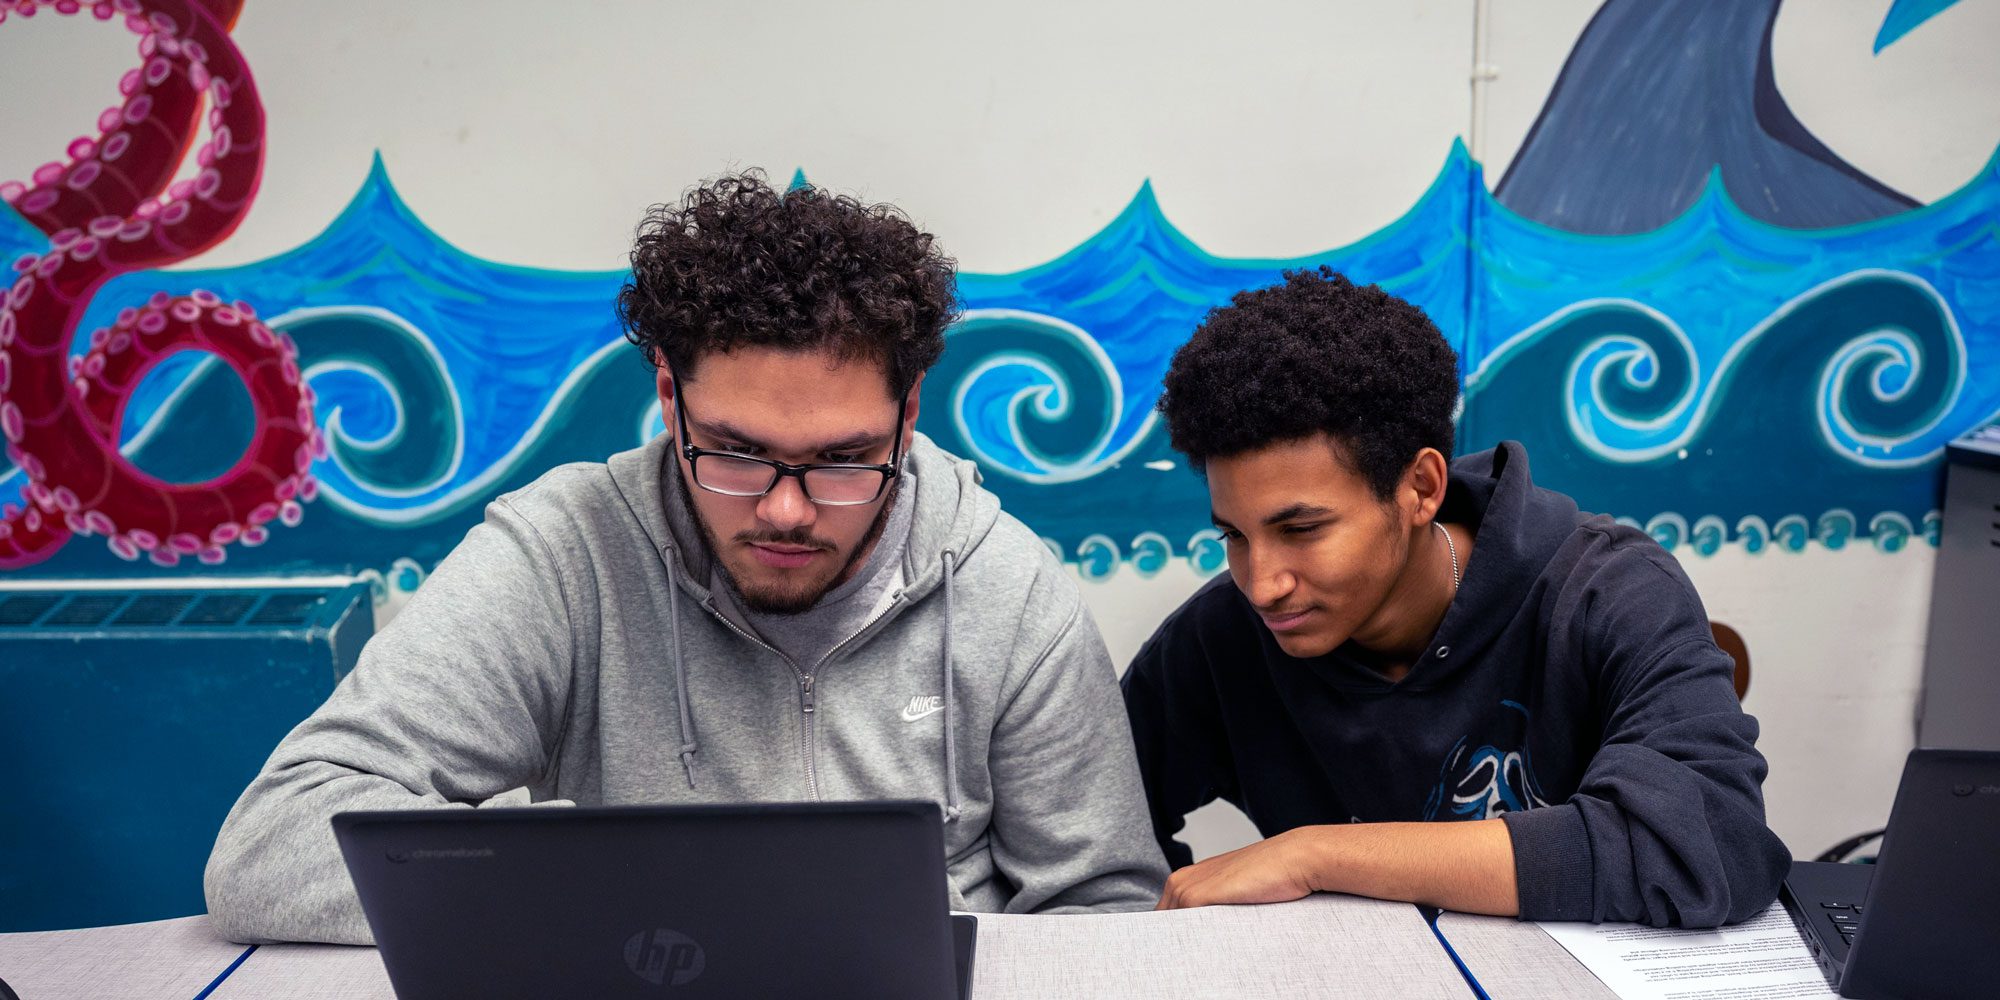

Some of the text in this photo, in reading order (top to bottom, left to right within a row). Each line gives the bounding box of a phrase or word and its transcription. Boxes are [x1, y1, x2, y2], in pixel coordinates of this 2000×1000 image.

[908, 696, 941, 712] NIKE
[411, 847, 495, 859] chromebook
[632, 928, 698, 985] hp
